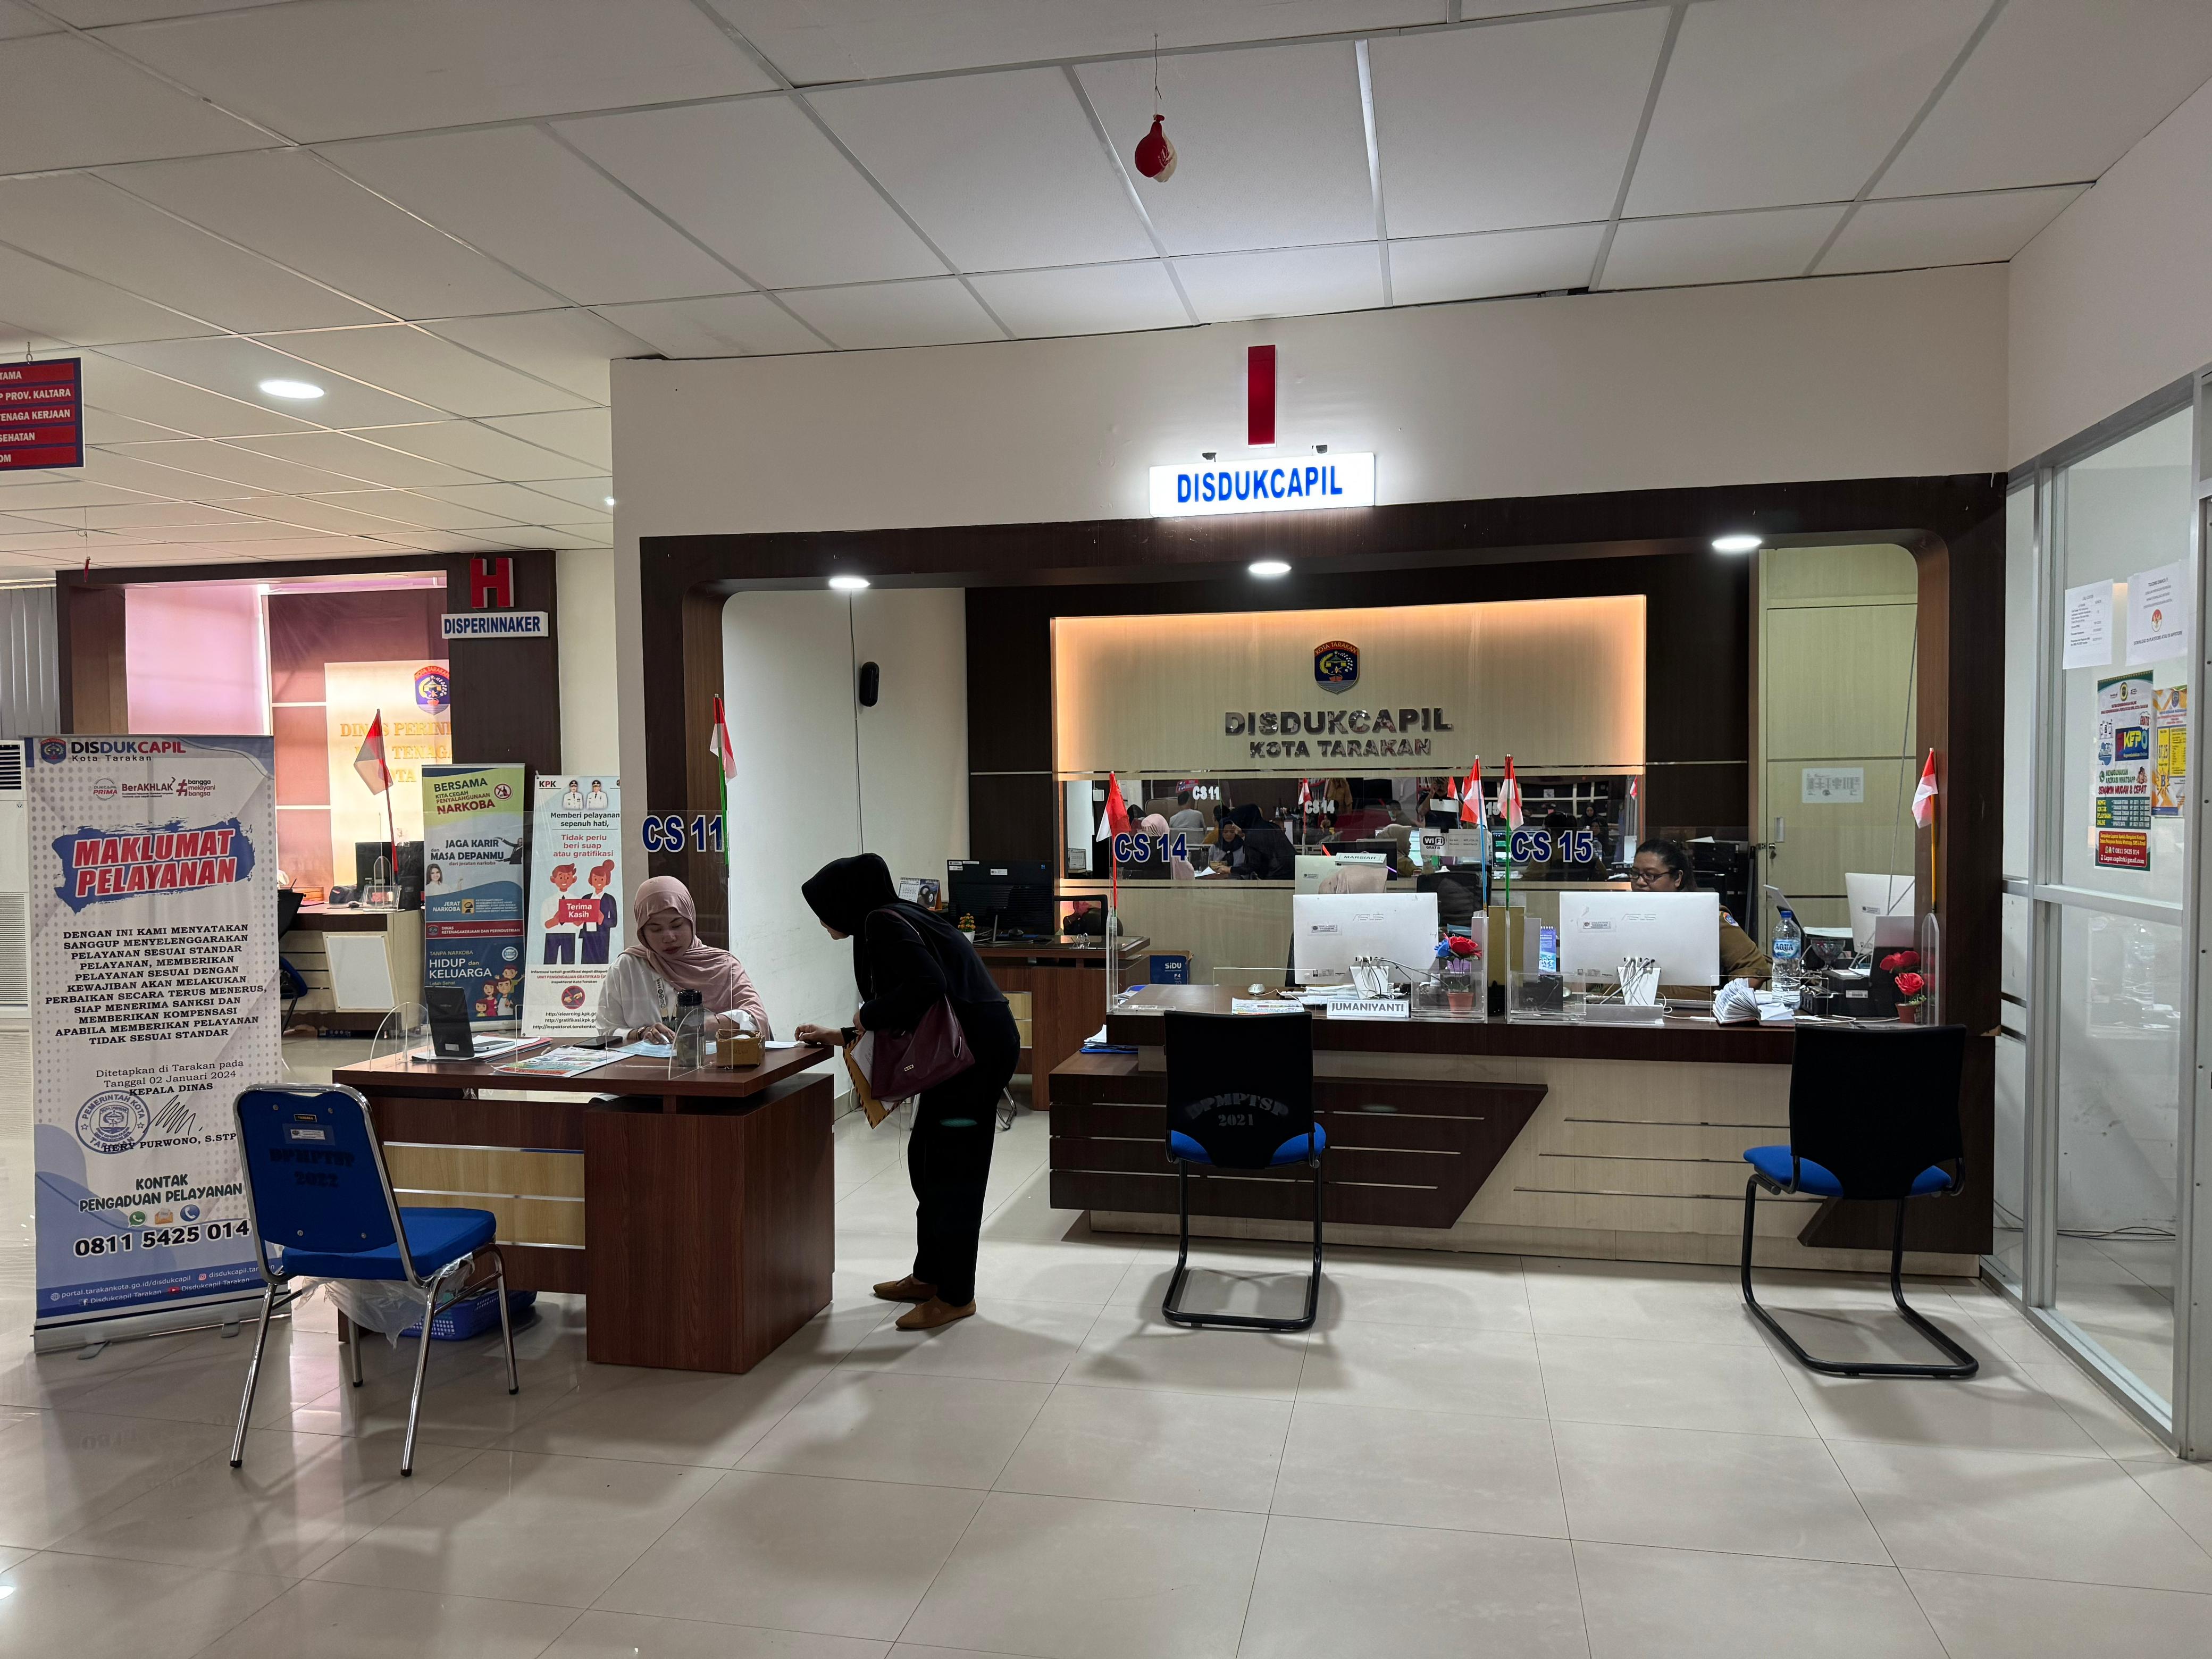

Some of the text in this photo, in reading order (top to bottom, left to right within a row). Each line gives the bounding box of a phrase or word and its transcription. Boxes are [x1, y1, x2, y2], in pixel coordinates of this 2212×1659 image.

[6, 389, 71, 400] PROV. KALTARA
[32, 409, 70, 419] KERJAAN
[1177, 465, 1343, 503] DISDUKCAPIL
[471, 558, 514, 608] H
[444, 616, 541, 634] DISPERINNAKER
[1315, 642, 1357, 655] KOTA TARAKAN
[1225, 708, 1453, 736] DISDUKCAPIL
[71, 741, 186, 753] DISDUKCAPIL
[1250, 738, 1431, 759] KOTA TARAKAN
[434, 778, 488, 792] BERSAMA
[1192, 786, 1207, 800] CS
[1209, 786, 1220, 800] 11
[436, 793, 490, 804] PENYALAHGUNAAN
[437, 799, 495, 815] NARKOBA
[1305, 800, 1335, 814] CS 14
[642, 814, 724, 853] CS 11
[73, 829, 235, 868] MAKLUMAT
[446, 840, 469, 848] JAGA
[1113, 832, 1187, 862] CS 14
[1511, 831, 1593, 863] CS 15
[431, 852, 455, 860] MASA
[76, 858, 237, 897] PELAYANAN
[63, 930, 112, 939] DENGAN
[171, 924, 248, 934] MENYATAKAN
[63, 934, 248, 950] SANGGUP MENYELENGGARAKAN
[71, 950, 140, 960] PELAYANAN
[189, 945, 242, 954] STANDAR
[80, 956, 234, 970] PELAYANAN, MEMBERIKAN
[430, 958, 465, 968] HIDUP
[75, 966, 239, 981] PELAYANAN SESUAI DENGAN
[430, 968, 492, 978] KELUARGA
[67, 982, 137, 992] KEWAJIBAN
[176, 976, 246, 986] MELAKUKAN
[45, 985, 266, 1004] PERBAIKAN SECARA TERUS MENERUS,
[106, 1001, 169, 1011] MENERIMA
[172, 999, 214, 1007] SANKSI
[1331, 1002, 1404, 1012] JUMANIYANTI
[79, 1007, 237, 1024] MEMBERIKAN KOMPENSASI
[55, 1016, 259, 1036] APABILA MEMBERIKAN PELAYANAN
[89, 1029, 229, 1045] TIDAK SESUAI STANDAR
[96, 1067, 155, 1078] Ditetapkan
[172, 1063, 215, 1072] Tarakan
[219, 1060, 244, 1071] pada
[104, 1077, 146, 1088] Tanggal
[166, 1072, 207, 1083] Januari
[211, 1070, 237, 1079] 2024
[129, 1083, 213, 1096] KEPALA DINAS
[82, 1094, 145, 1119] PEMERINTAH KOTA
[1185, 1093, 1289, 1119] DPMPTSP
[1218, 1114, 1254, 1126] 2021
[103, 1133, 237, 1152] HERY PURWONO, S.STP
[136, 1174, 188, 1191] KONTAK
[80, 1183, 242, 1212] PENGADUAN PELAYANAN
[74, 1220, 249, 1256] 0811 5425 014
[62, 1275, 191, 1298] portal.tarakankota.go.id/disdukcapil
[90, 1277, 249, 1304] Disdukcapil Tarakan Disdukcapil Tarakan
